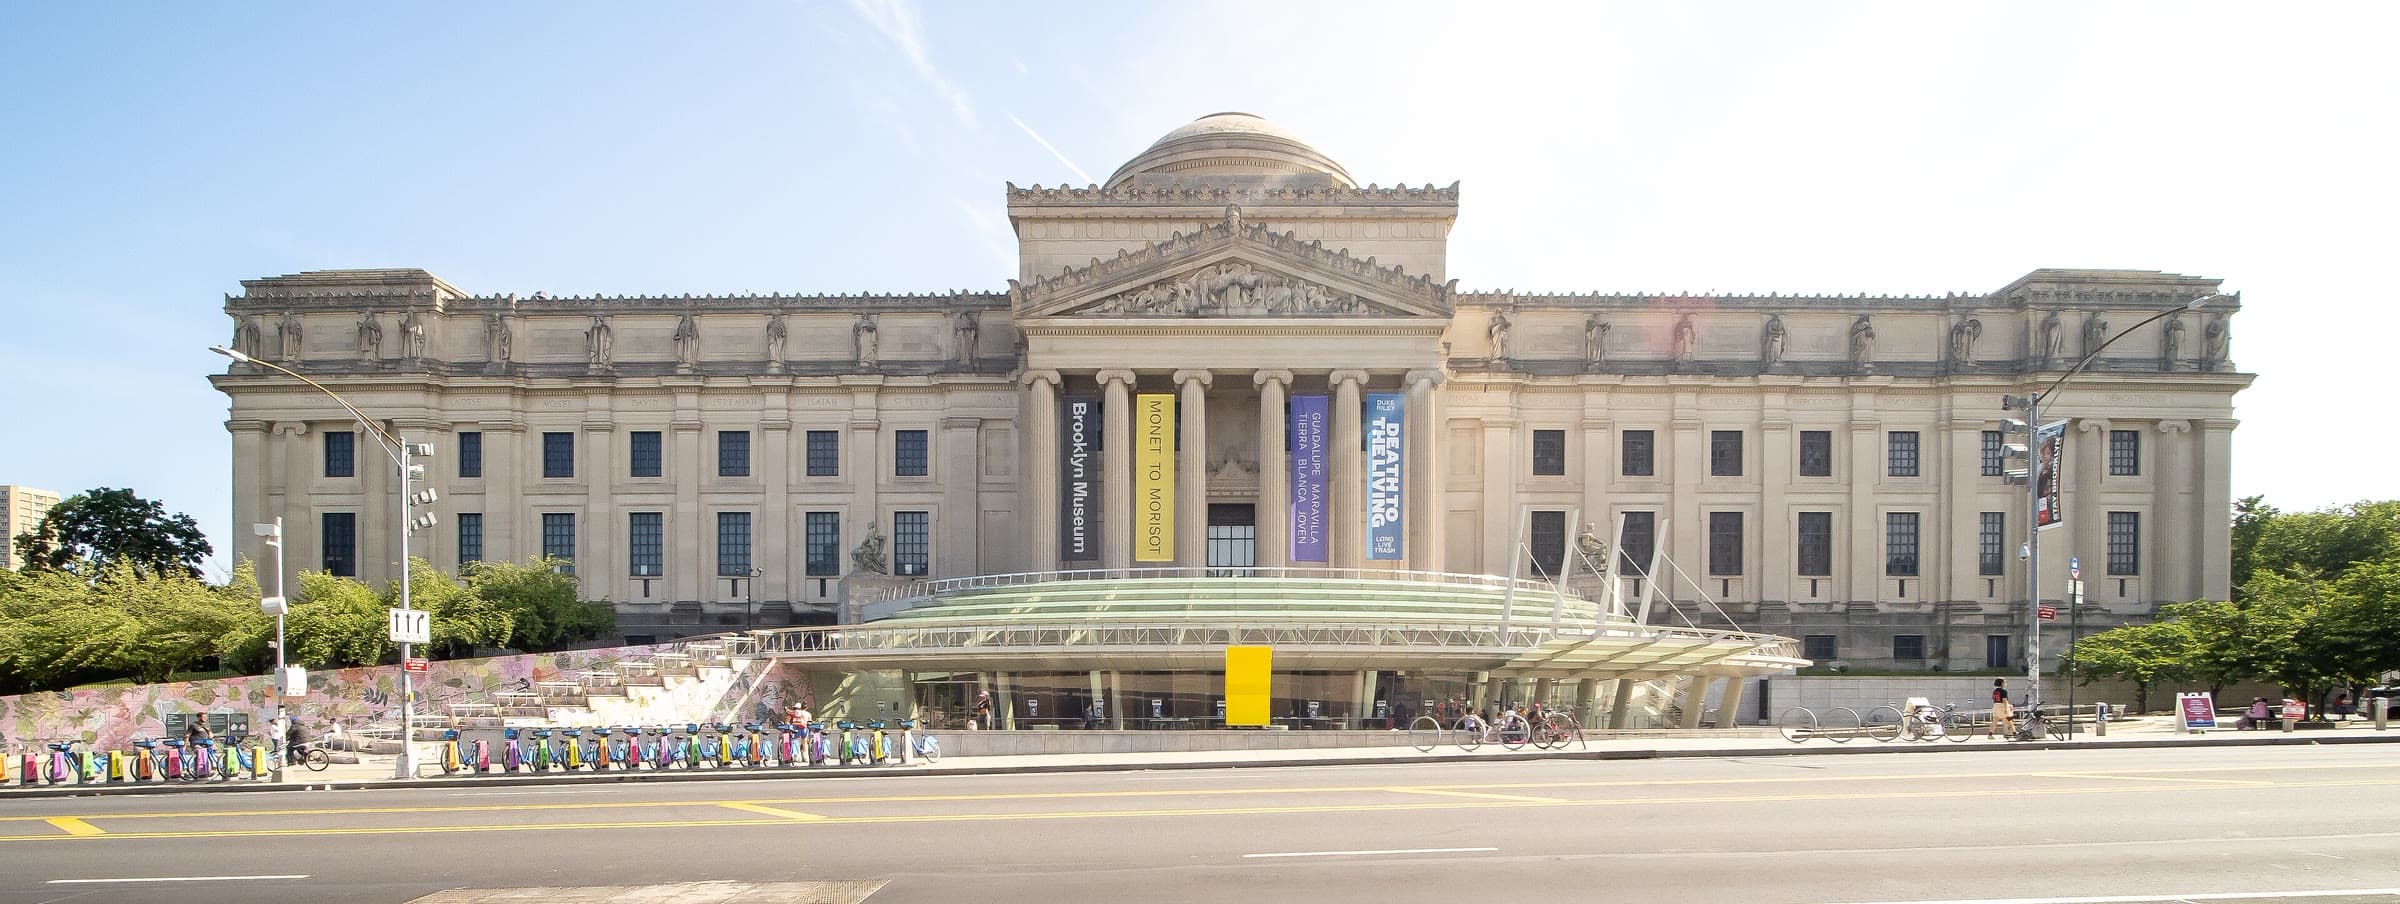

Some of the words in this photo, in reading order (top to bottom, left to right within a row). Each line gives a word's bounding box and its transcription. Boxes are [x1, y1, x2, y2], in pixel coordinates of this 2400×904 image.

[543, 400, 572, 408] MOSE
[1149, 400, 1162, 455] MONET
[1071, 402, 1088, 479] Brooklyn
[1297, 412, 1309, 452] TIERRA
[1311, 412, 1321, 476] GUADALUPE
[1371, 416, 1386, 457] THE
[1386, 422, 1400, 492] DEATH
[1149, 462, 1162, 481] TO
[1297, 458, 1308, 503] BLANCA
[1371, 458, 1386, 528] LIVING
[1072, 482, 1088, 554] Museum
[1148, 488, 1162, 555] MORISOT
[1297, 510, 1307, 545] JOVEN
[1310, 484, 1321, 545] MARAVILLA
[1385, 494, 1399, 522] TO
